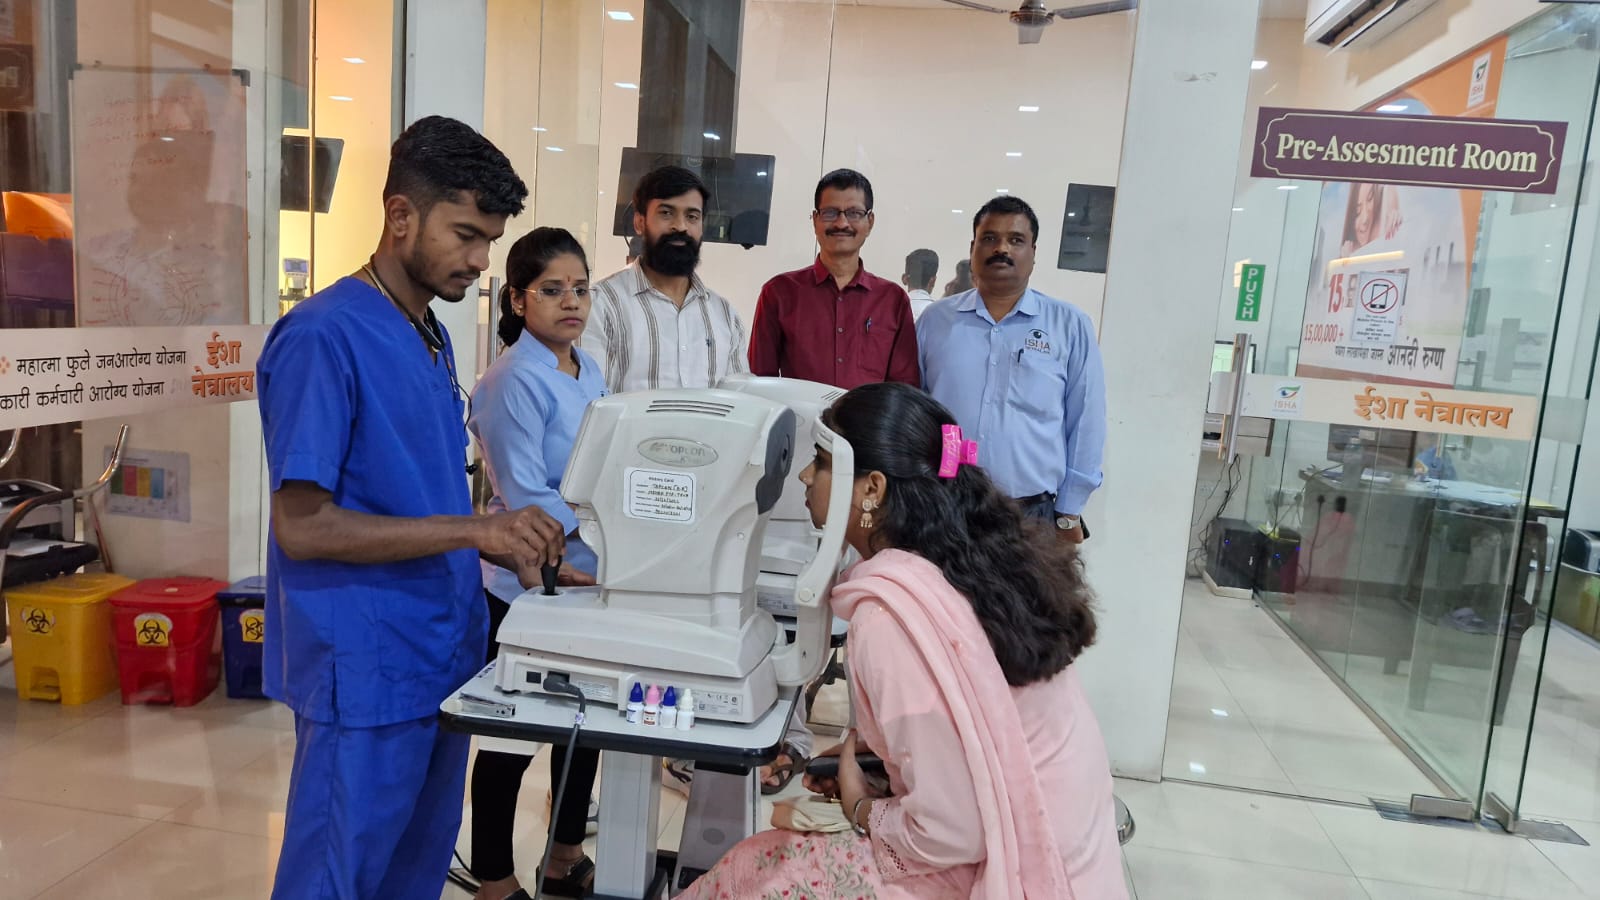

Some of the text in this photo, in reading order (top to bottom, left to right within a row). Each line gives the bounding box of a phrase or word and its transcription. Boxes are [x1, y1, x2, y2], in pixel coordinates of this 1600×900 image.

[1275, 133, 1537, 172] Pre-Assesment Room
[1242, 268, 1258, 318] PUSH
[206, 331, 241, 368] ईशा
[1024, 338, 1051, 350] ISHA
[1387, 336, 1419, 366] आनंदी
[1422, 346, 1446, 369] रुग्ण
[16, 345, 187, 378] महात्मा फुले जनआरोग्य योजना
[36, 382, 83, 407] कर्मचारी
[89, 380, 128, 401] आरोग्य
[132, 377, 165, 397] योजना
[191, 365, 255, 398] नेत्रालय
[1354, 386, 1513, 429] ईशा नेत्रालय
